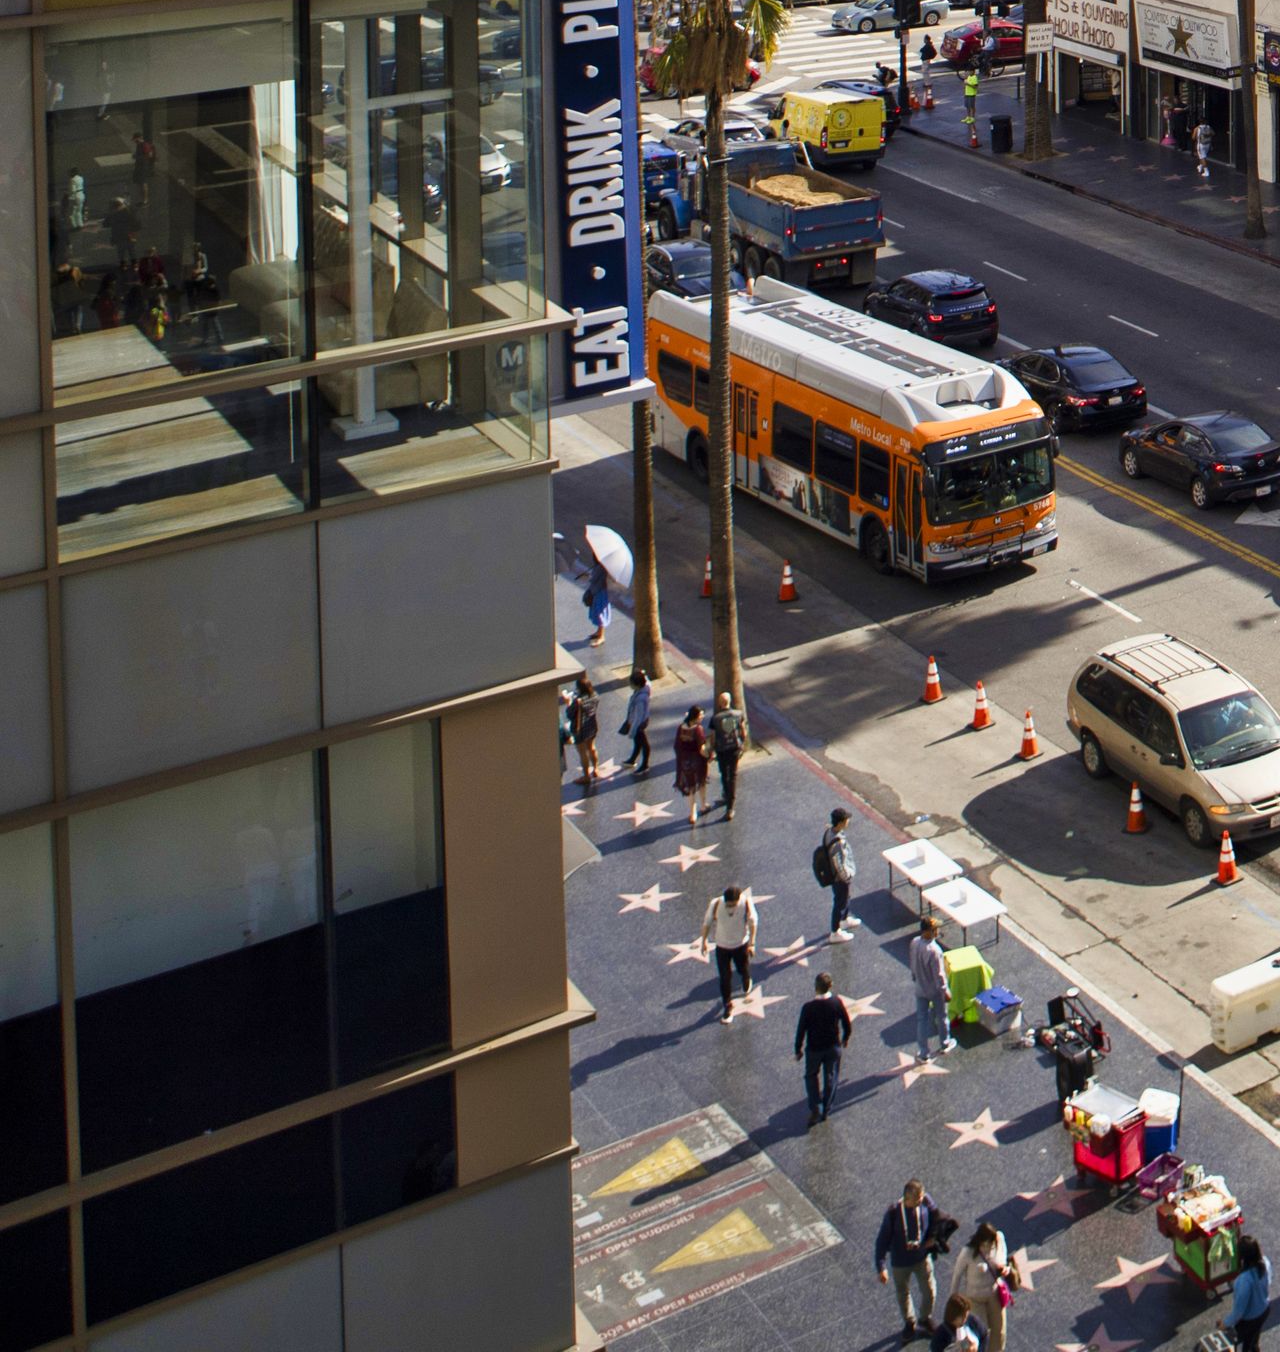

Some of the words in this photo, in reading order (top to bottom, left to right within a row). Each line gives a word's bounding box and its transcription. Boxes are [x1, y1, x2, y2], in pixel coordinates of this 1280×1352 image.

[1081, 0, 1129, 30] SOUVENIRS
[1183, 18, 1218, 37] OLLYWOOD
[1081, 23, 1115, 49] PHOTO
[564, 98, 625, 248] DRINK
[572, 305, 630, 388] EAT
[739, 332, 783, 371] Metro
[850, 417, 872, 438] Metro
[872, 427, 892, 447] Local
[579, 1249, 603, 1266] MAY
[605, 1237, 638, 1255] OPEN
[638, 1213, 696, 1241] SUDDENLY
[626, 1312, 651, 1329] MAY
[653, 1298, 686, 1317] OPEN
[687, 1272, 746, 1303] SUDDENLY
